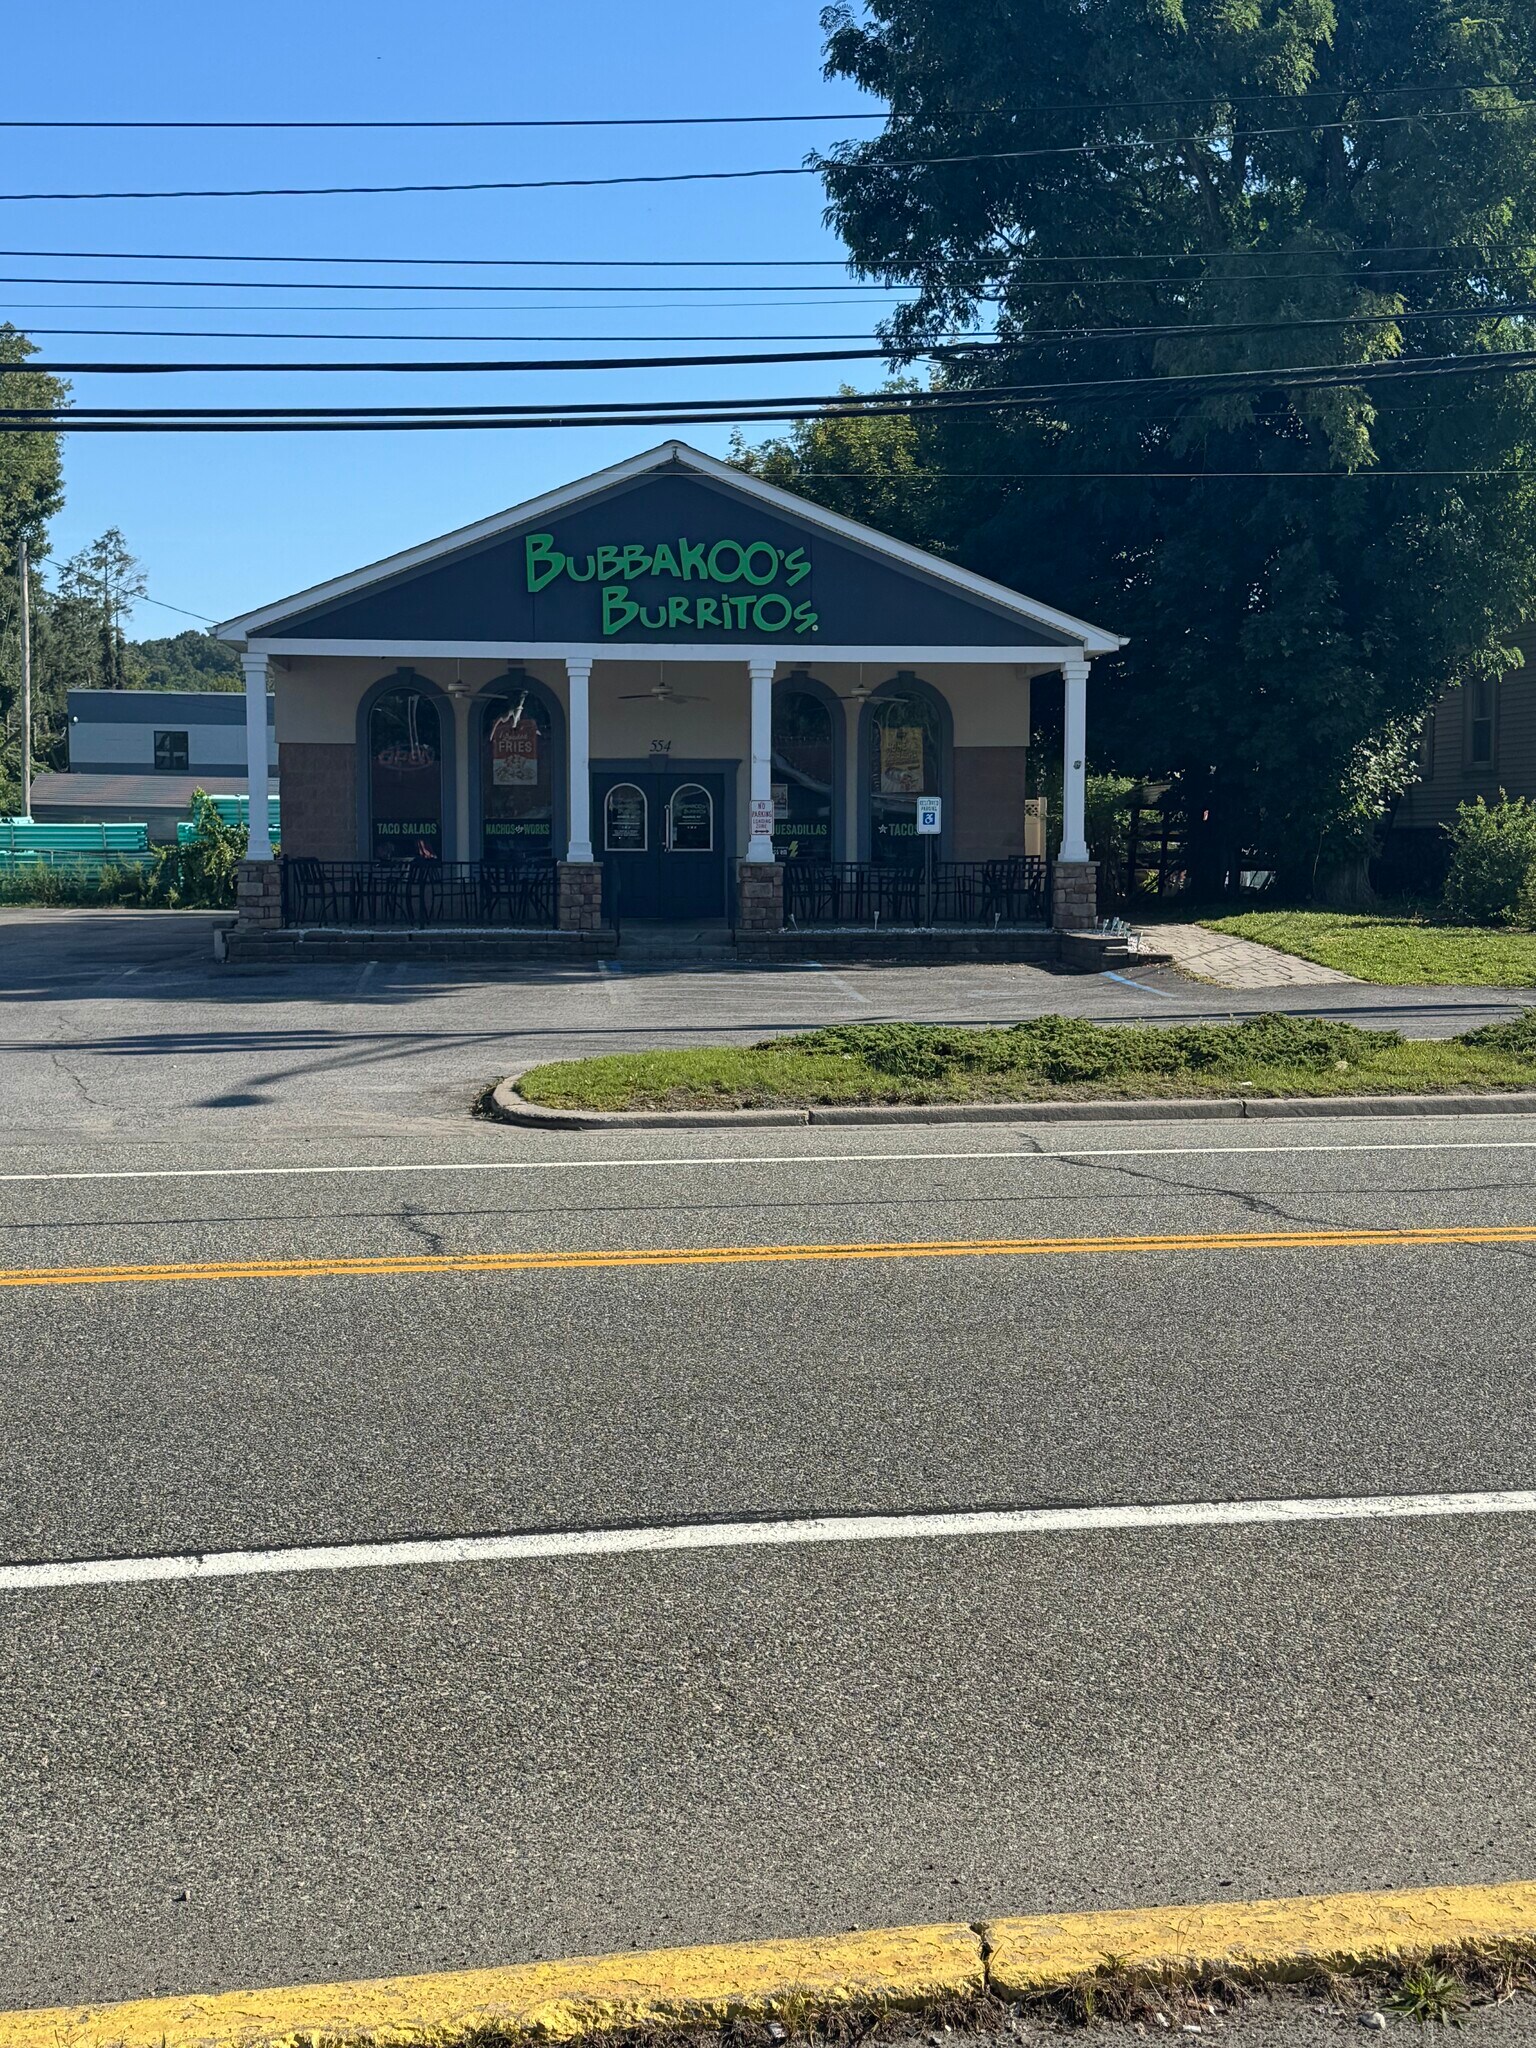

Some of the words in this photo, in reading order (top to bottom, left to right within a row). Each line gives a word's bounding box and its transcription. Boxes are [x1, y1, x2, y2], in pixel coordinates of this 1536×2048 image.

[525, 533, 812, 593] BUBBAKOO'S
[498, 741, 533, 753] FRIES
[649, 739, 672, 752] 554
[377, 823, 400, 835] TACO
[401, 823, 437, 835] SALADS
[485, 823, 515, 835] NACHOS
[524, 823, 550, 835] WORKS
[774, 824, 827, 836] UESADILLAS
